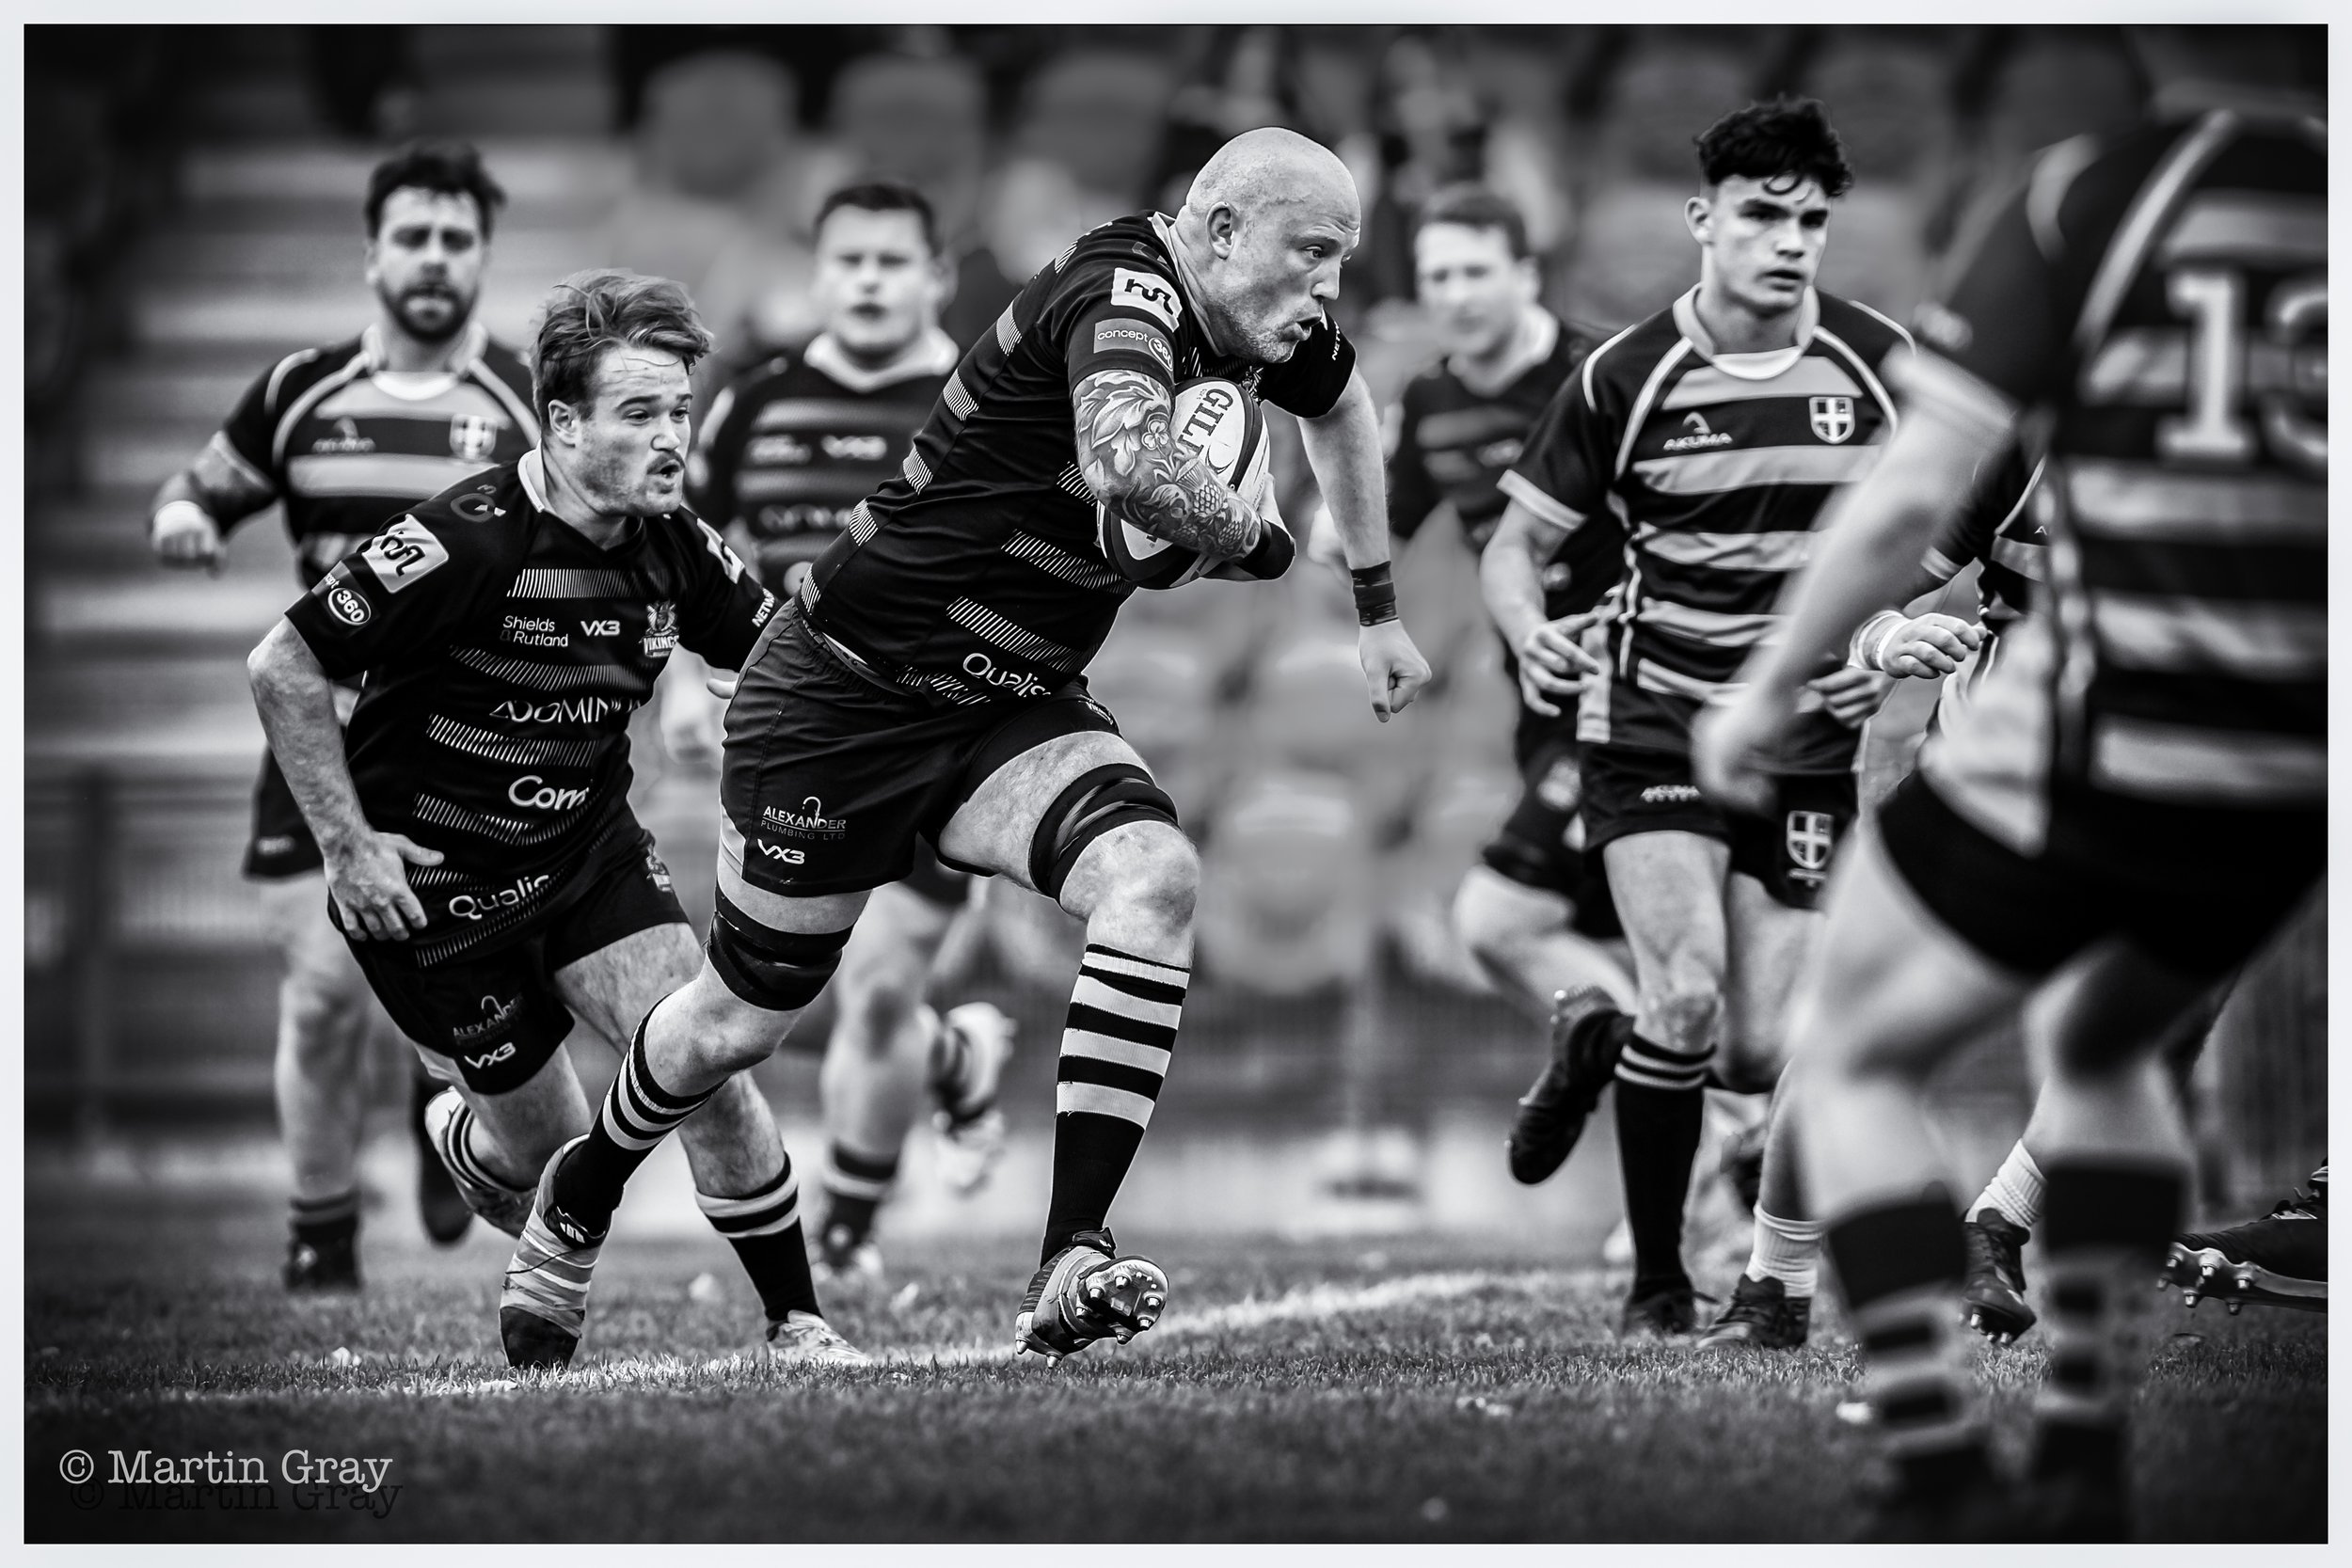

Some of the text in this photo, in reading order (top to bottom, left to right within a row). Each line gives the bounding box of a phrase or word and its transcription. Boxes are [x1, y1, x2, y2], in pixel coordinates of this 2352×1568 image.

[1097, 329, 1148, 341] concept
[336, 589, 366, 623] 360
[502, 615, 556, 632] Shields
[580, 620, 621, 637] VX3
[513, 630, 569, 647] Rutland
[763, 805, 847, 830] ALEXANDER
[760, 819, 846, 841] PLUMBING LTD
[757, 838, 805, 864] VX3
[464, 1041, 516, 1069] VX3
